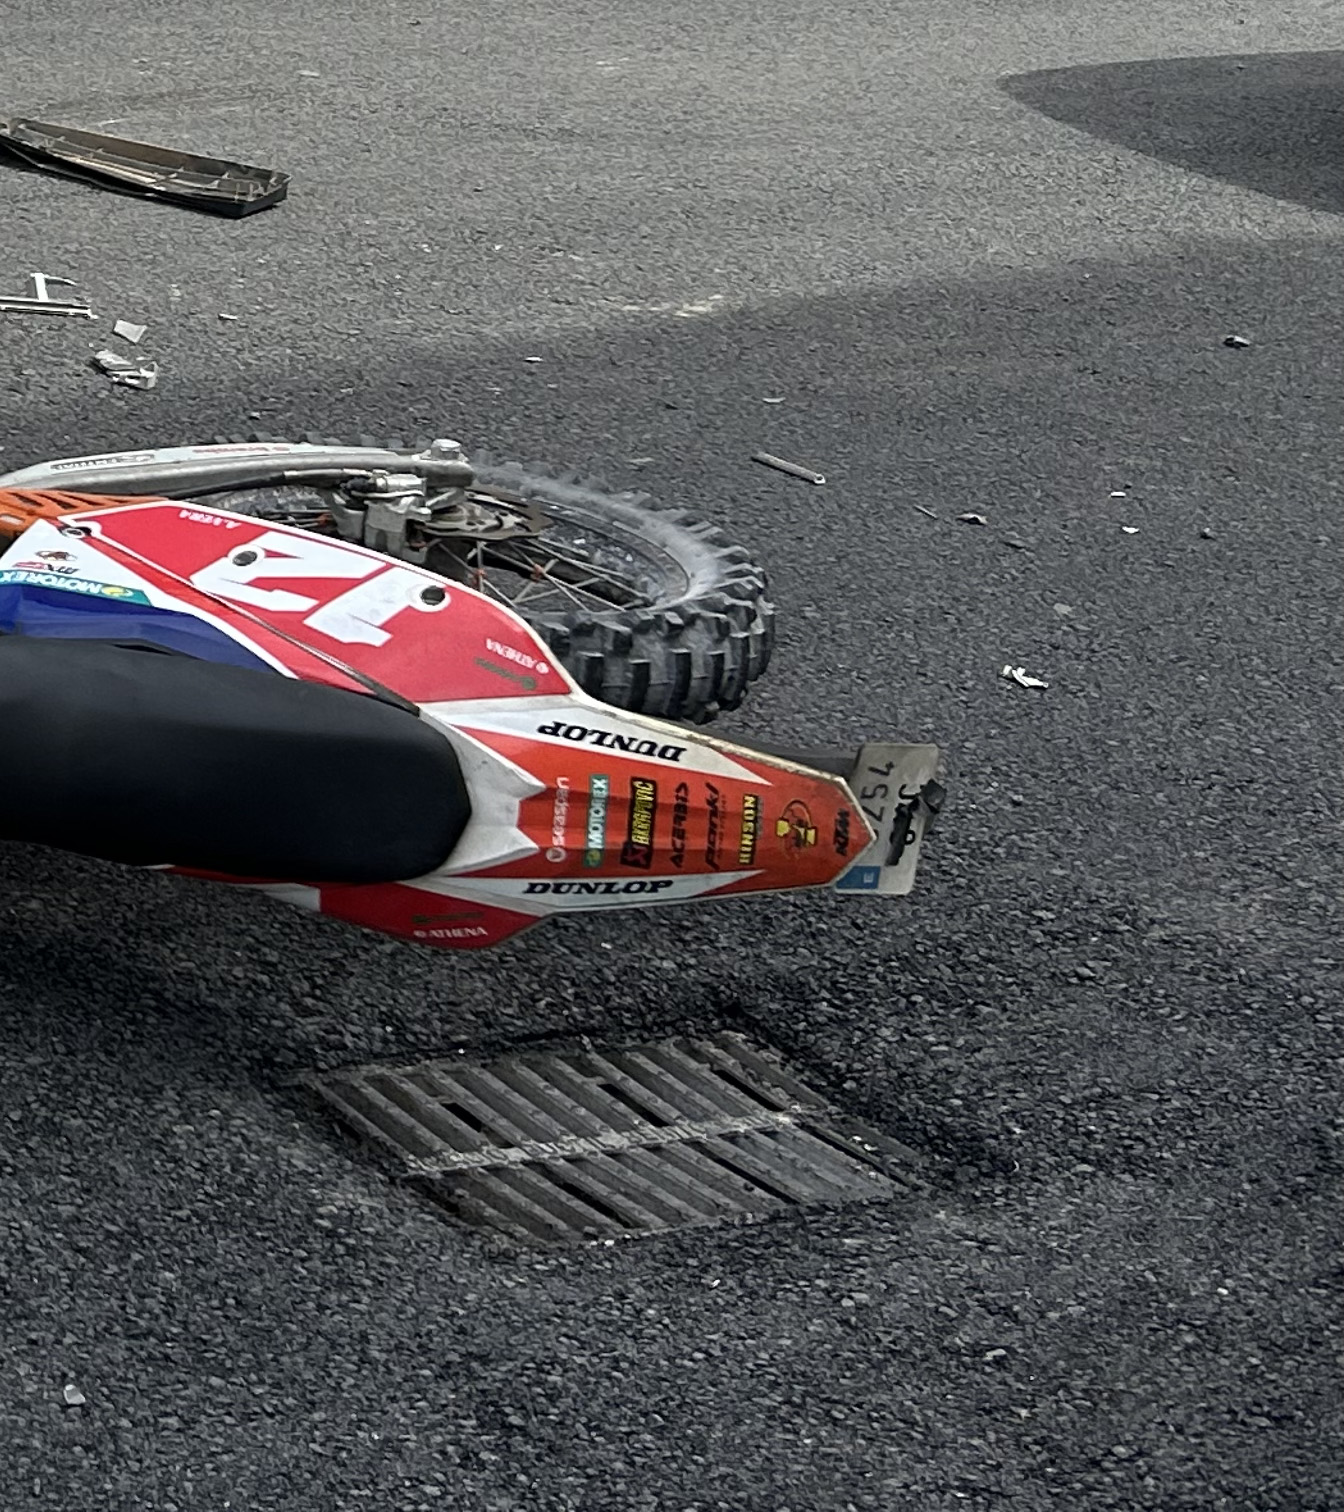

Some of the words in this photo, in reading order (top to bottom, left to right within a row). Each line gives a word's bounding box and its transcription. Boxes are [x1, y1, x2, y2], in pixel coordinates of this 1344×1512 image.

[0, 570, 109, 594] MOTOREX
[537, 720, 687, 763] DUNLOP
[671, 782, 690, 868] ACERBIS
[740, 795, 757, 865] HINSON
[524, 879, 673, 895] DUNLOP
[429, 926, 488, 938] ATHENA
